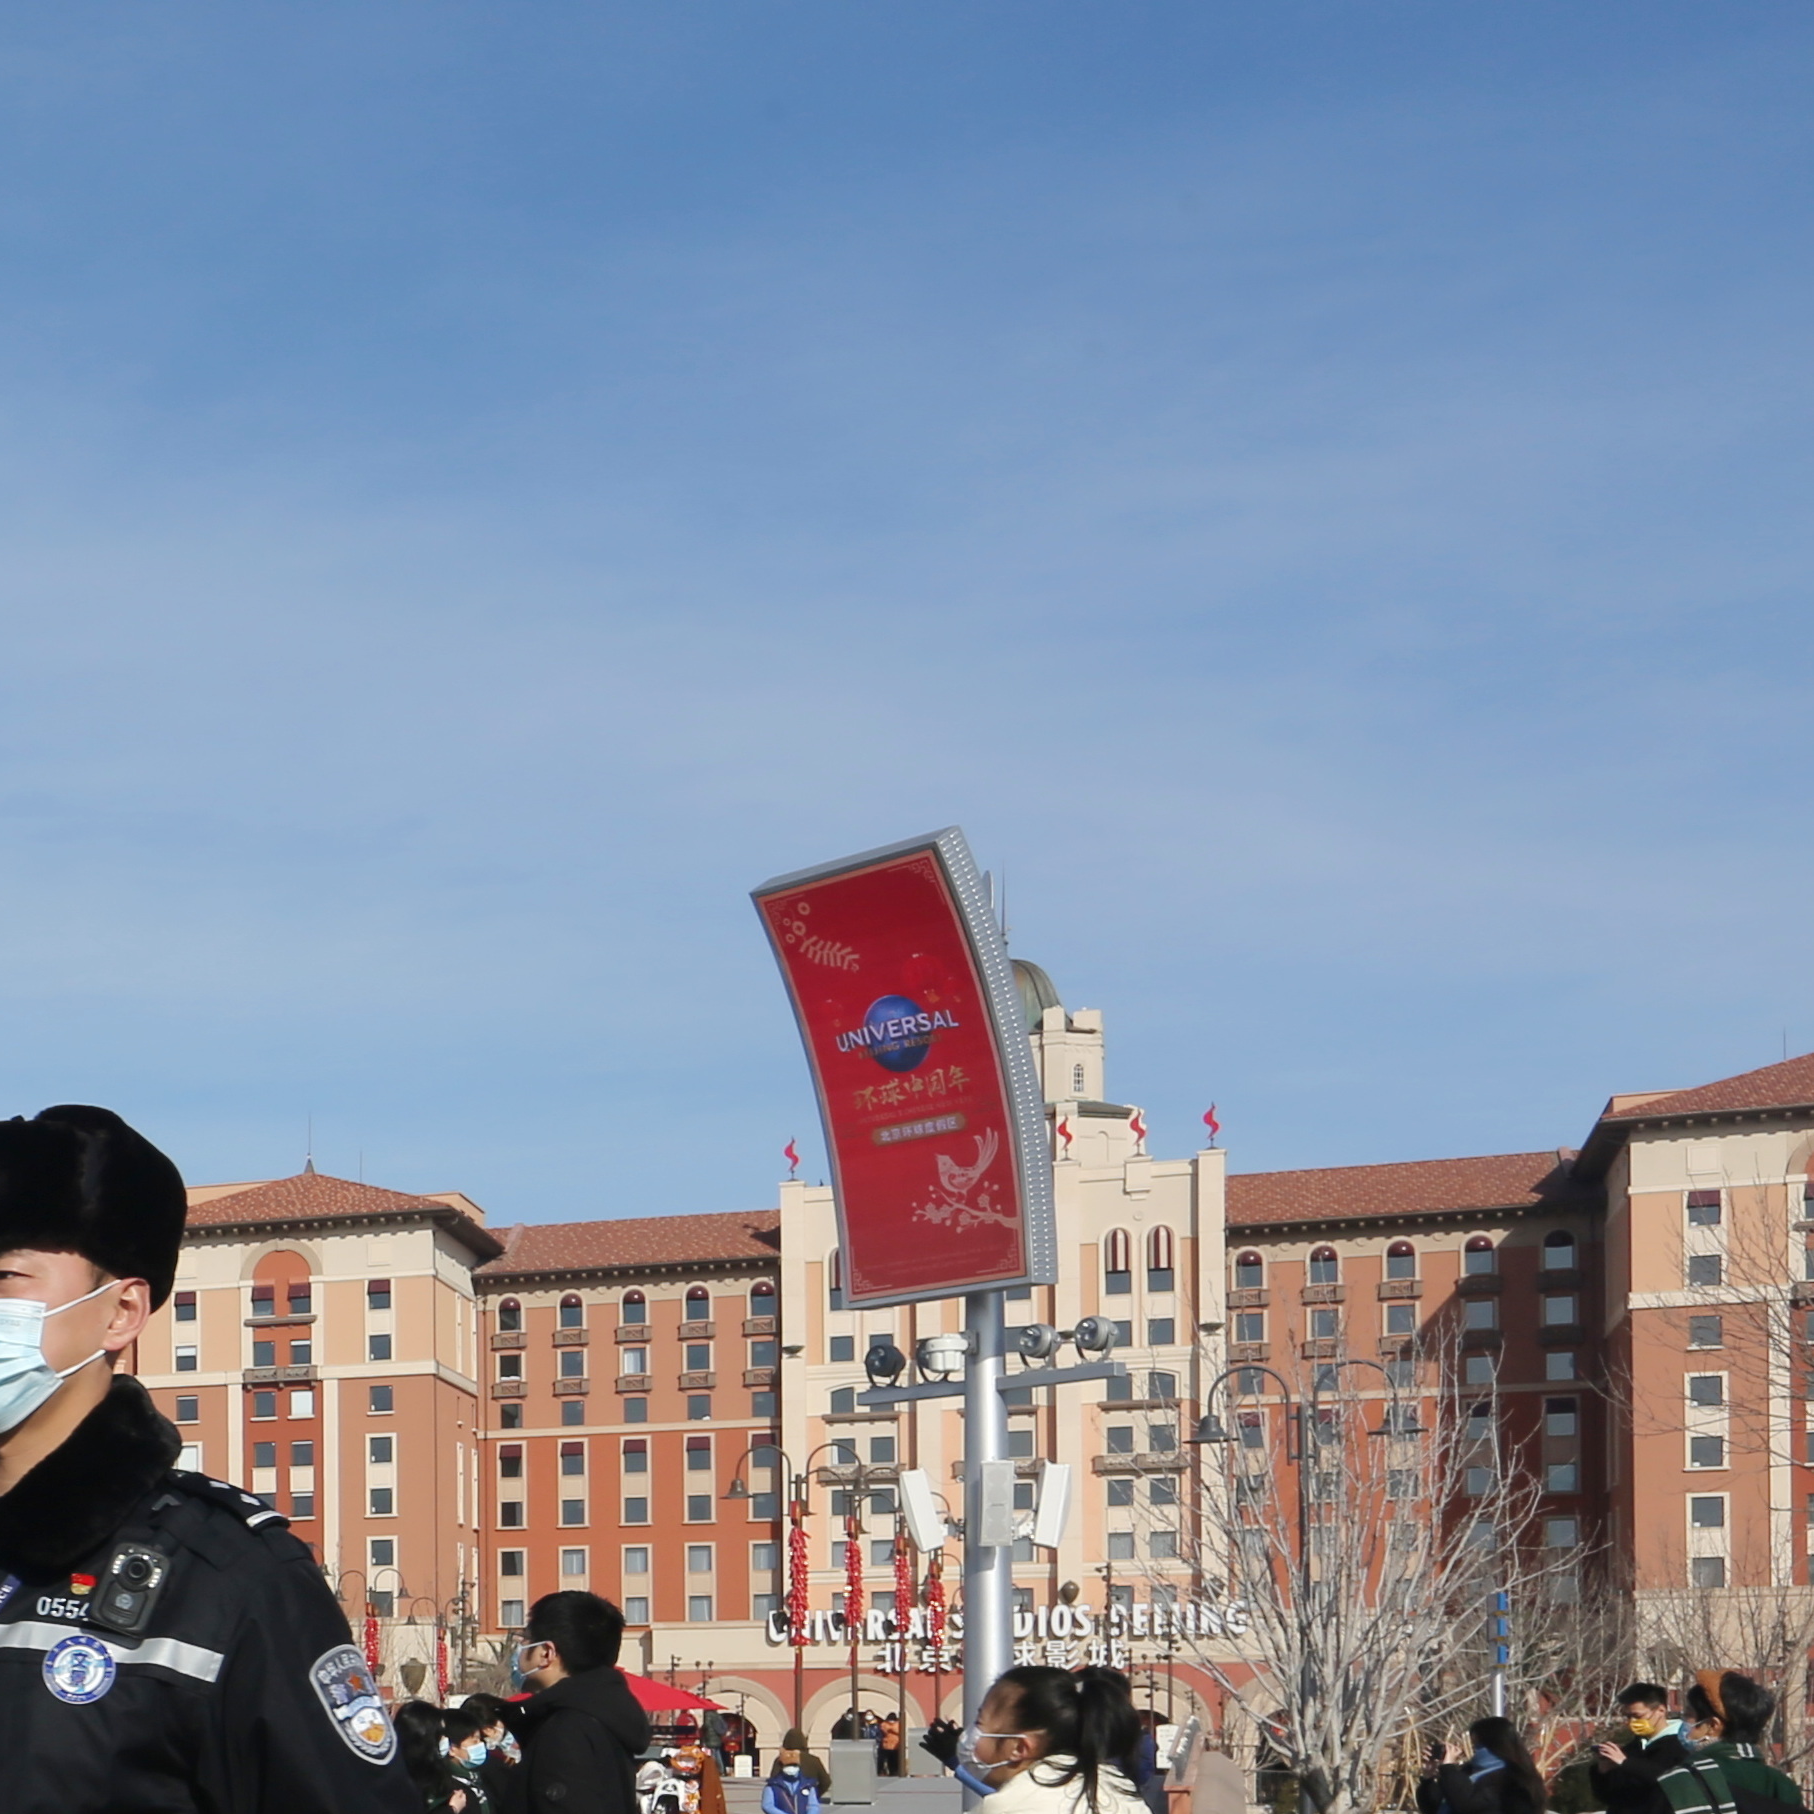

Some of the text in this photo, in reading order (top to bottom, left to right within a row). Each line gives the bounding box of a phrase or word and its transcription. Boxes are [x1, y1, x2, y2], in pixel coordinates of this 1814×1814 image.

[836, 1009, 959, 1052] UNIVERSAL
[852, 1065, 970, 1111] 环球中国年
